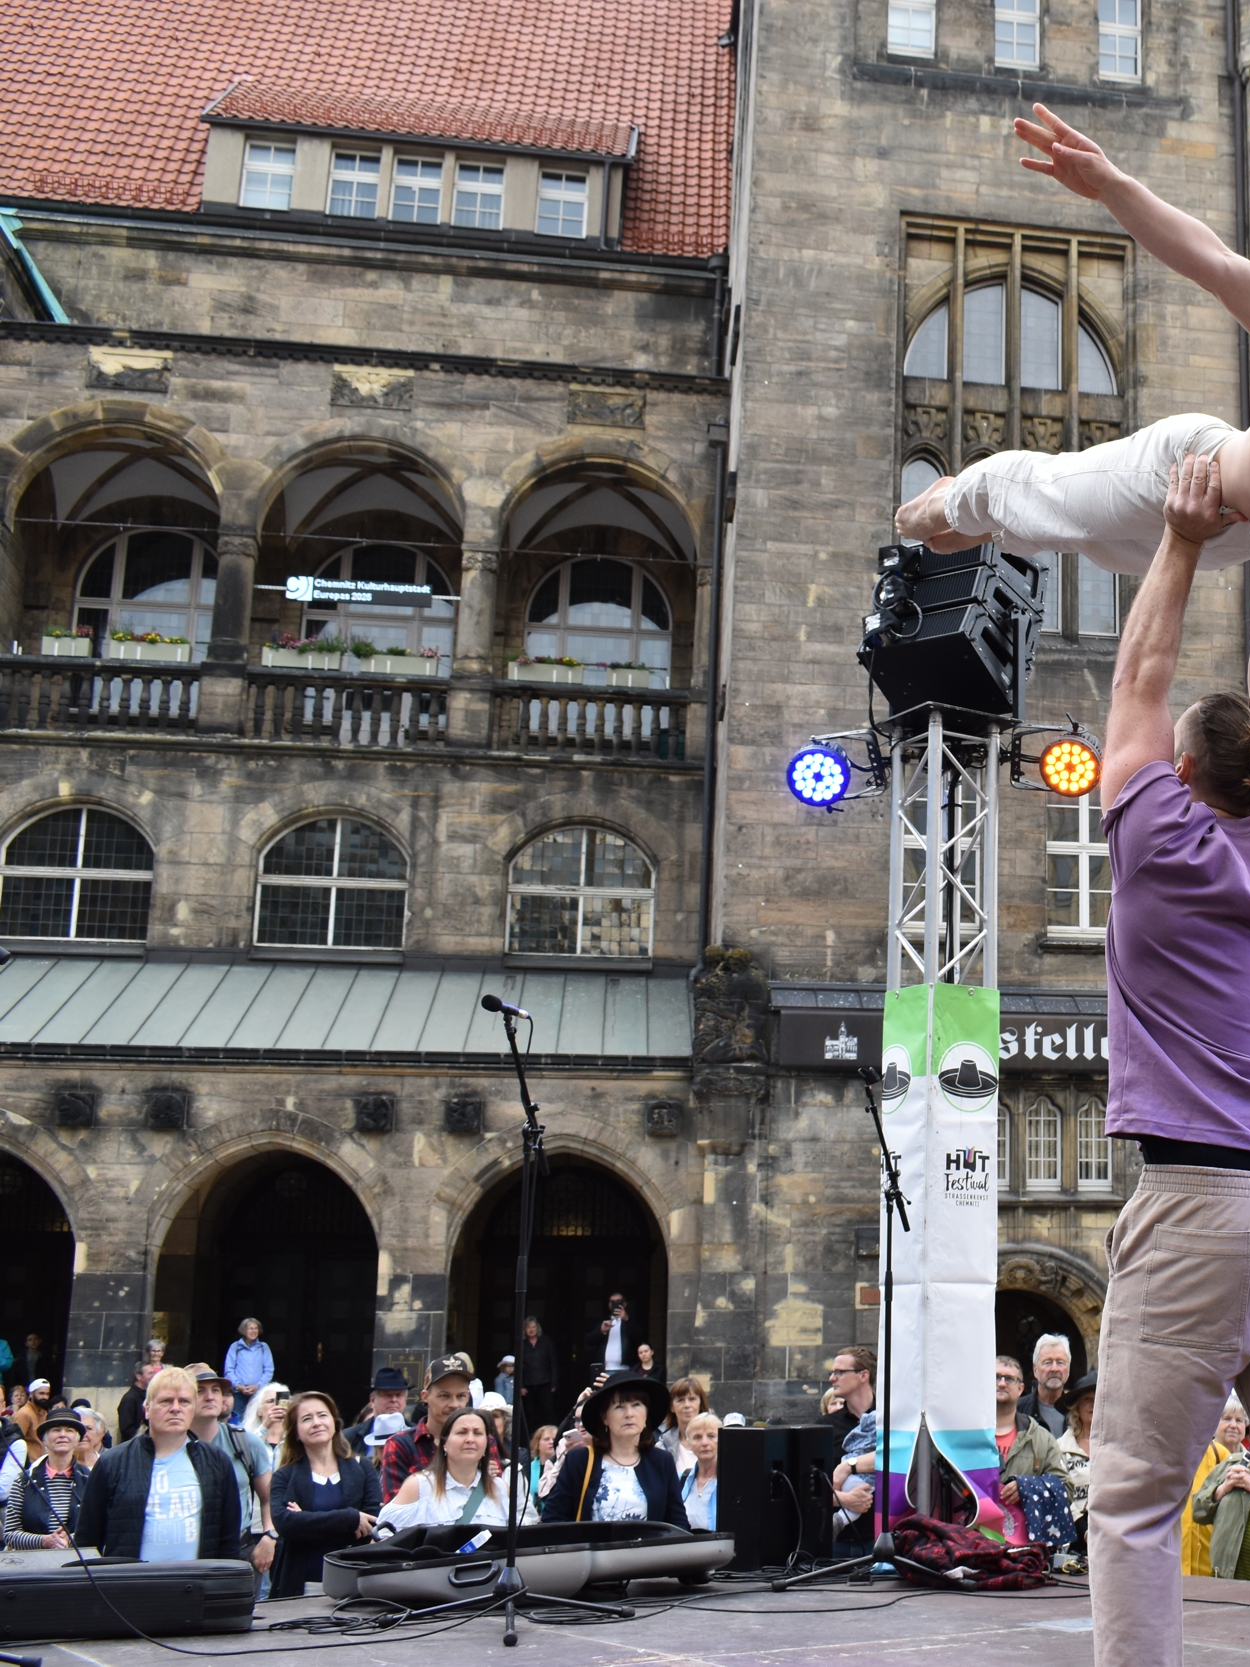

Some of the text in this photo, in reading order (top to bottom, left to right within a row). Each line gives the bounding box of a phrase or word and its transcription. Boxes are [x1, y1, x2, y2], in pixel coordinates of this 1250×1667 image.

[314, 578, 431, 594] Chemnitz Kulturhauptstadt
[313, 590, 372, 601] Europas 2025
[945, 1145, 990, 1172] HUT
[944, 1171, 989, 1192] Festival
[944, 1192, 989, 1201] STRASSENKUNST
